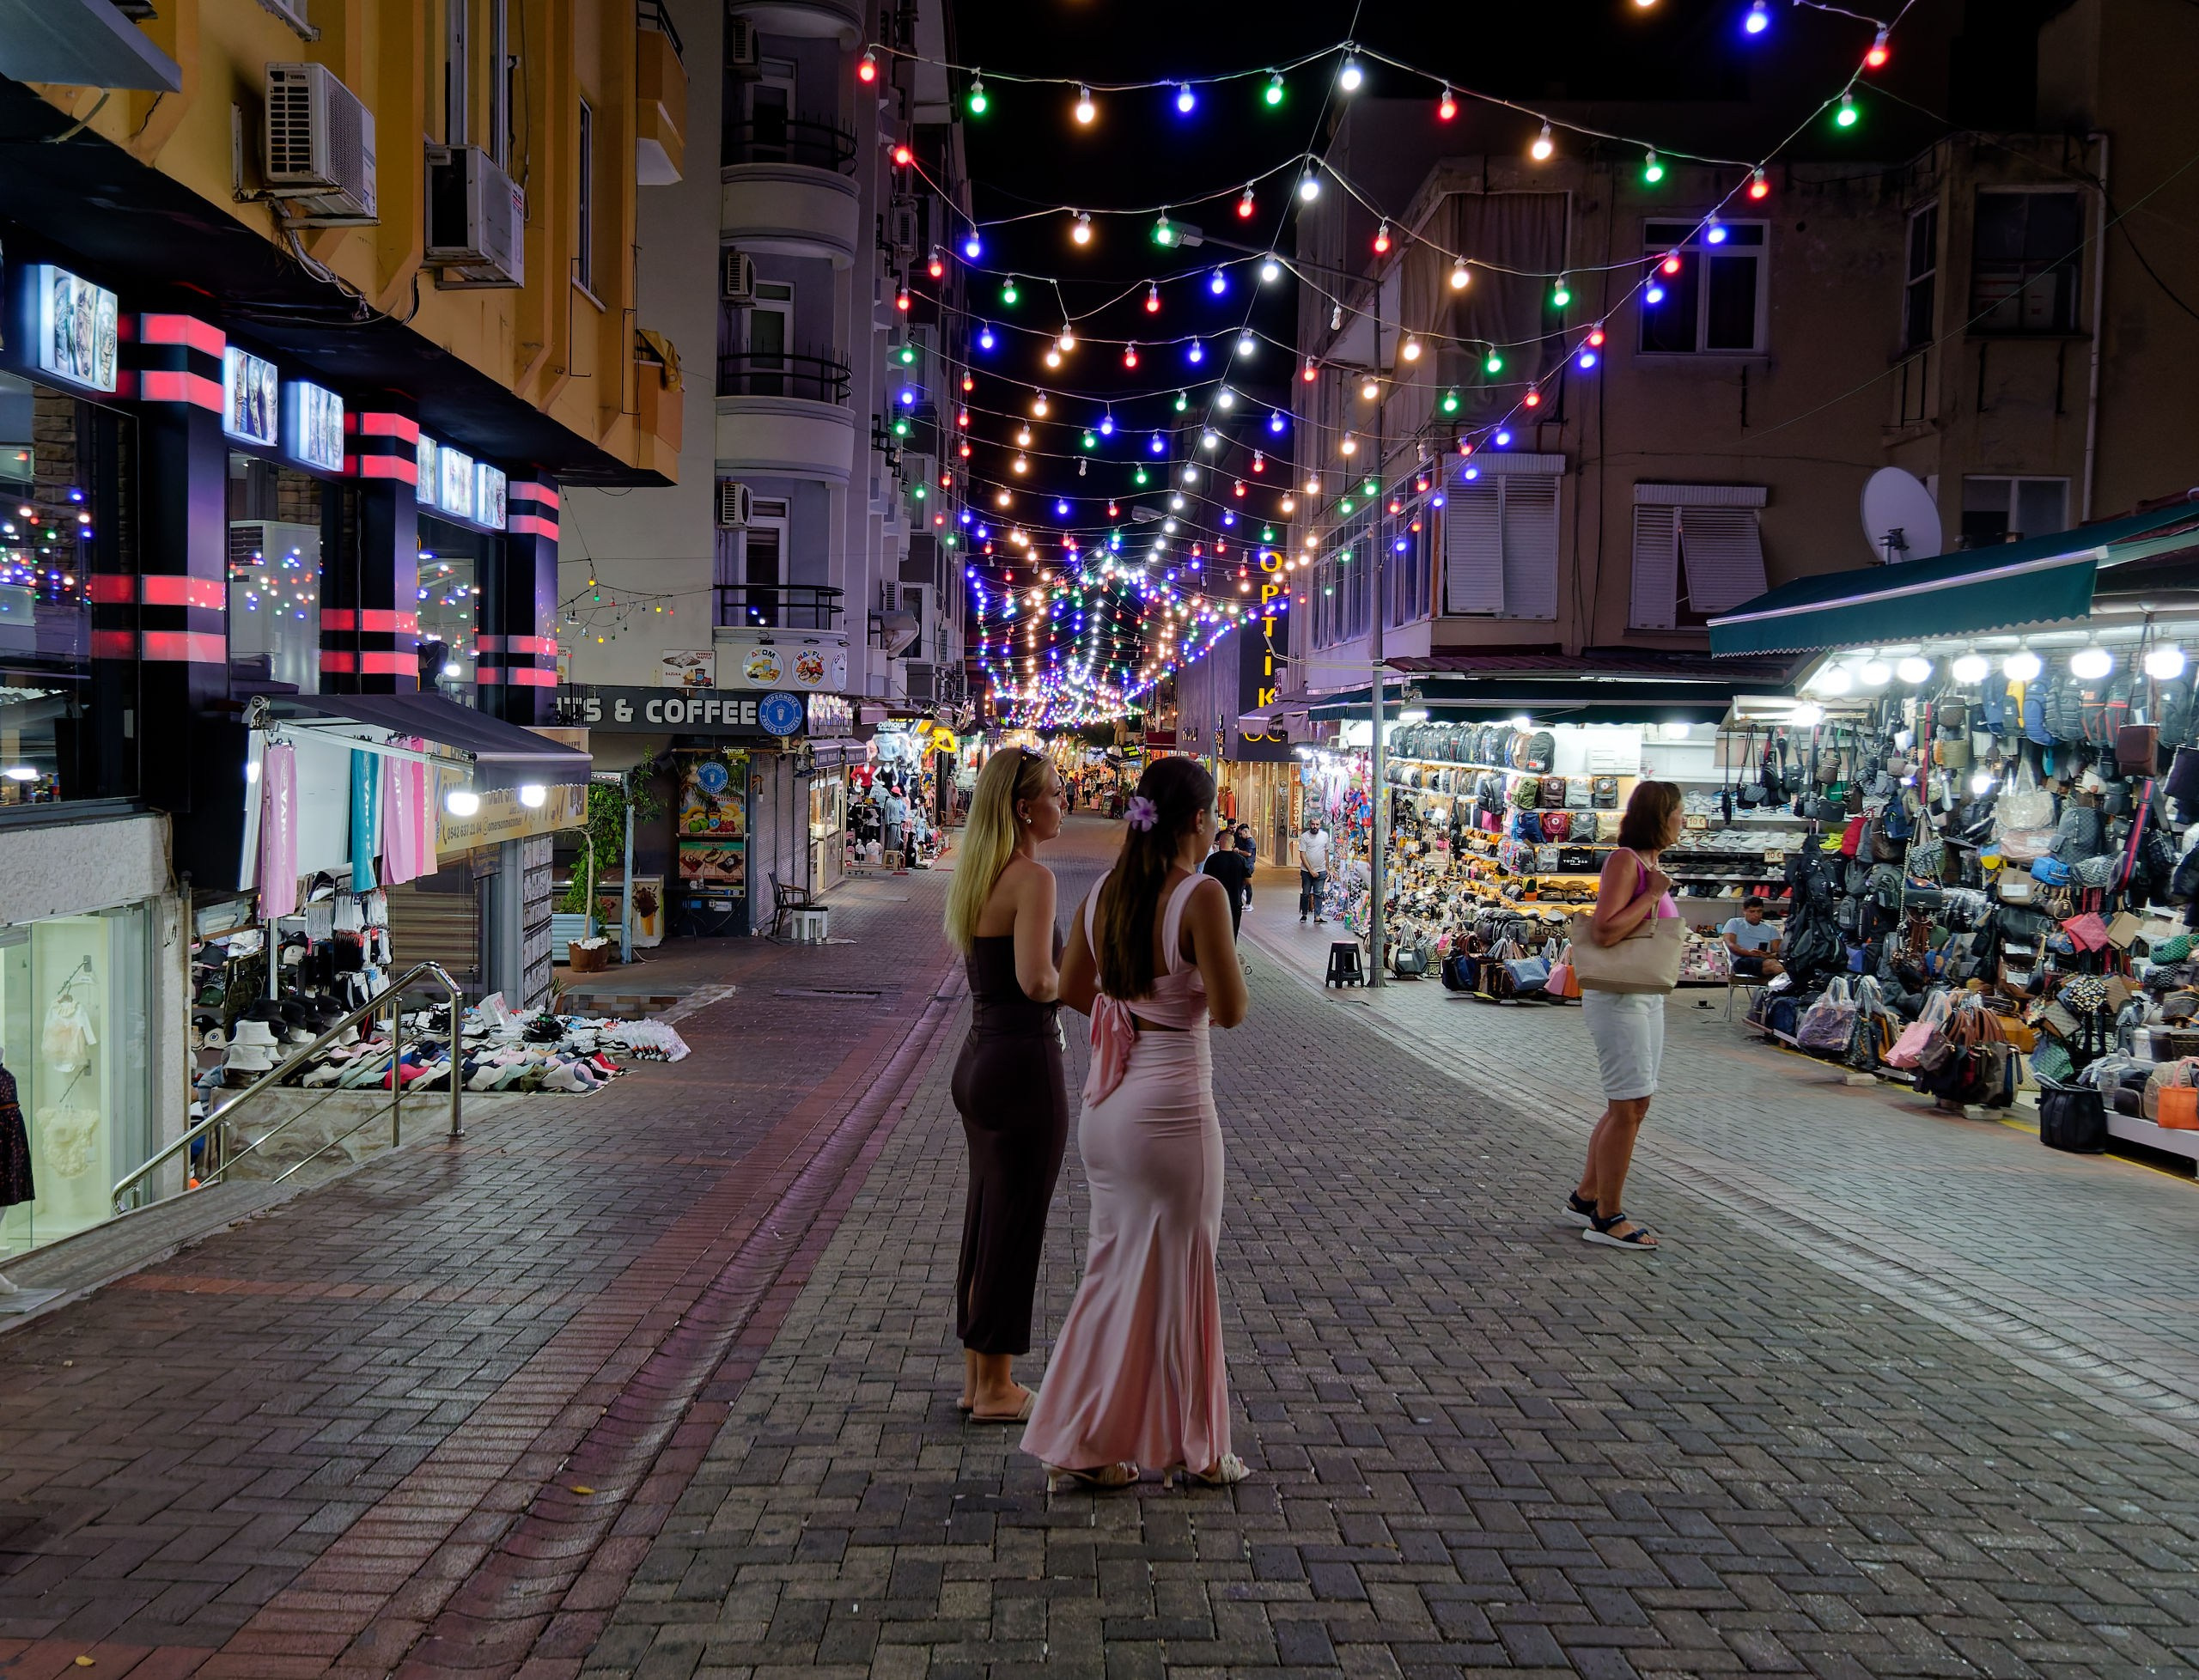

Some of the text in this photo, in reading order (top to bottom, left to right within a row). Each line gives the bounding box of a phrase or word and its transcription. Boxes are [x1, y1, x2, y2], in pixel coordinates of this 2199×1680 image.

[752, 649, 777, 659] ATOM
[796, 650, 825, 662] WAFFLE
[764, 694, 799, 708] SUPERNOVA
[614, 698, 634, 723] &
[645, 698, 757, 725] COFFEE
[783, 716, 801, 733] COFFEE
[1534, 926, 1566, 936] BOSS
